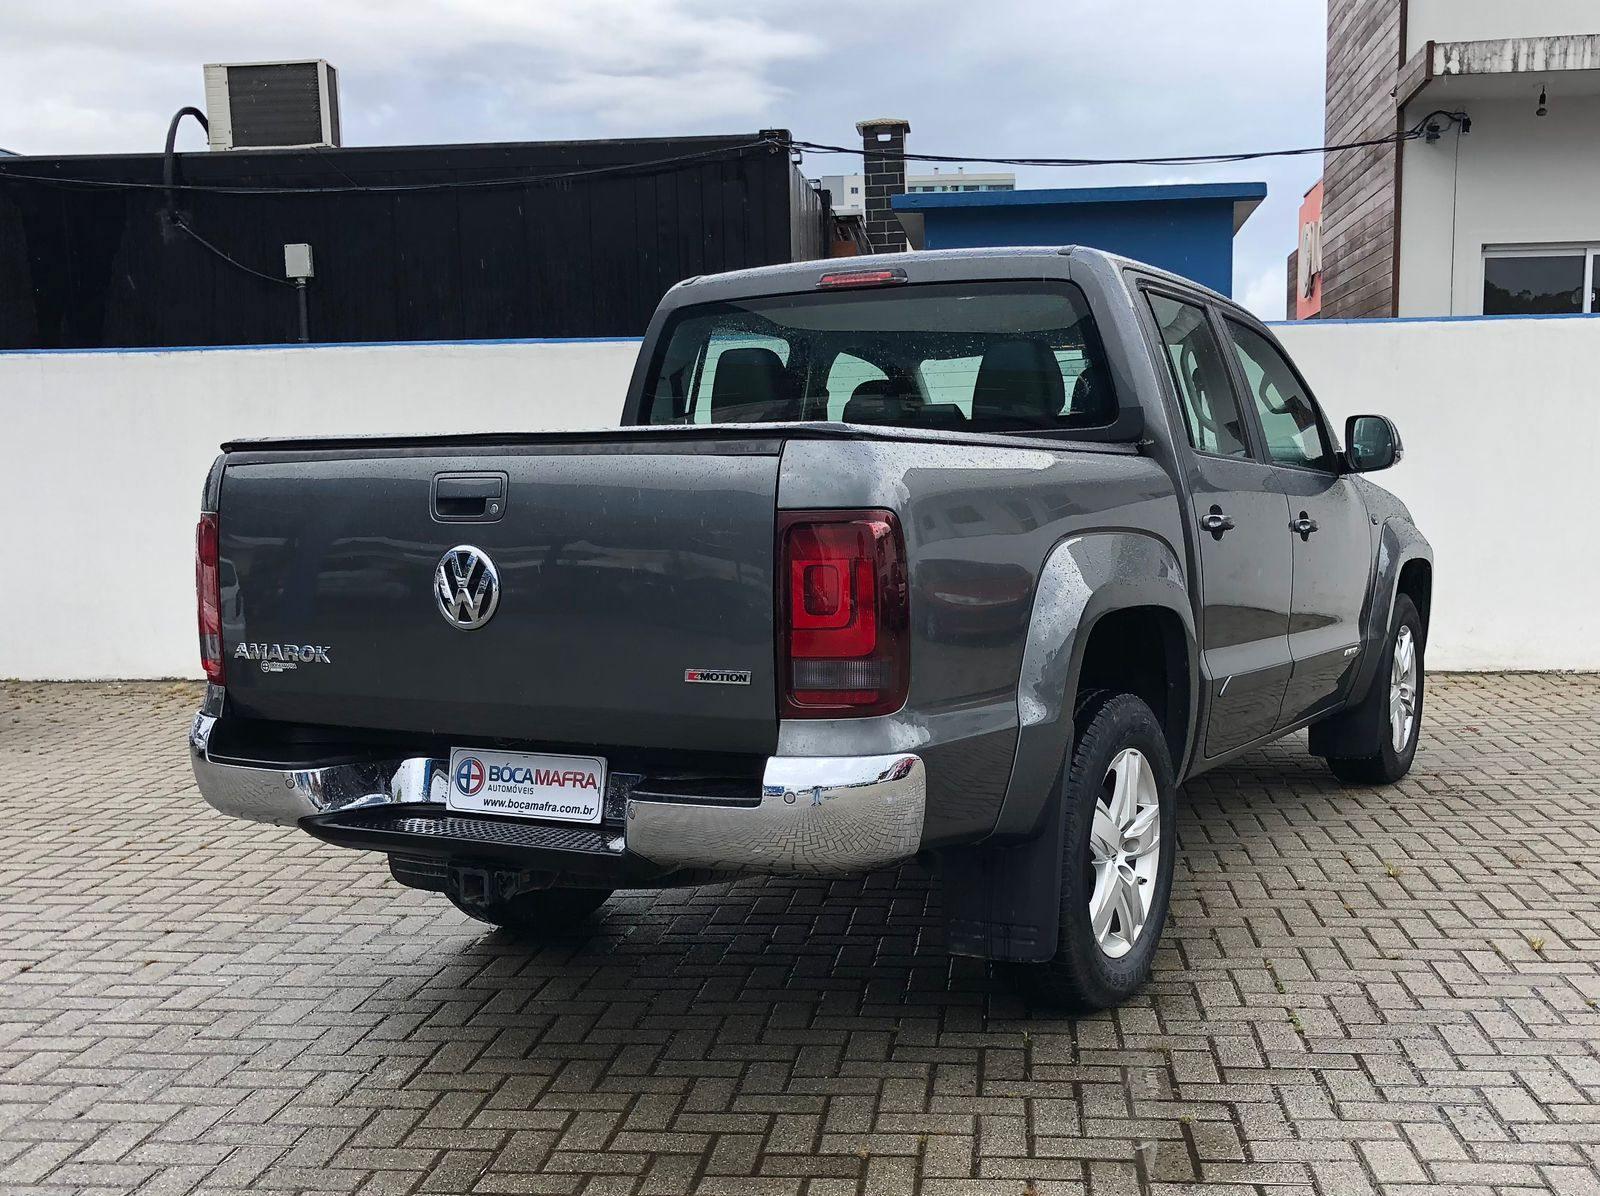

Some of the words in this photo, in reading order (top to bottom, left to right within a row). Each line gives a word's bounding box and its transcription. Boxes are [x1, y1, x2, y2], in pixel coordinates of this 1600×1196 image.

[437, 547, 498, 627] VW
[233, 642, 331, 664] AMAROK
[487, 784, 534, 795] AUTOMÓVEIS
[483, 798, 594, 815] www.bocamafra.com.br
